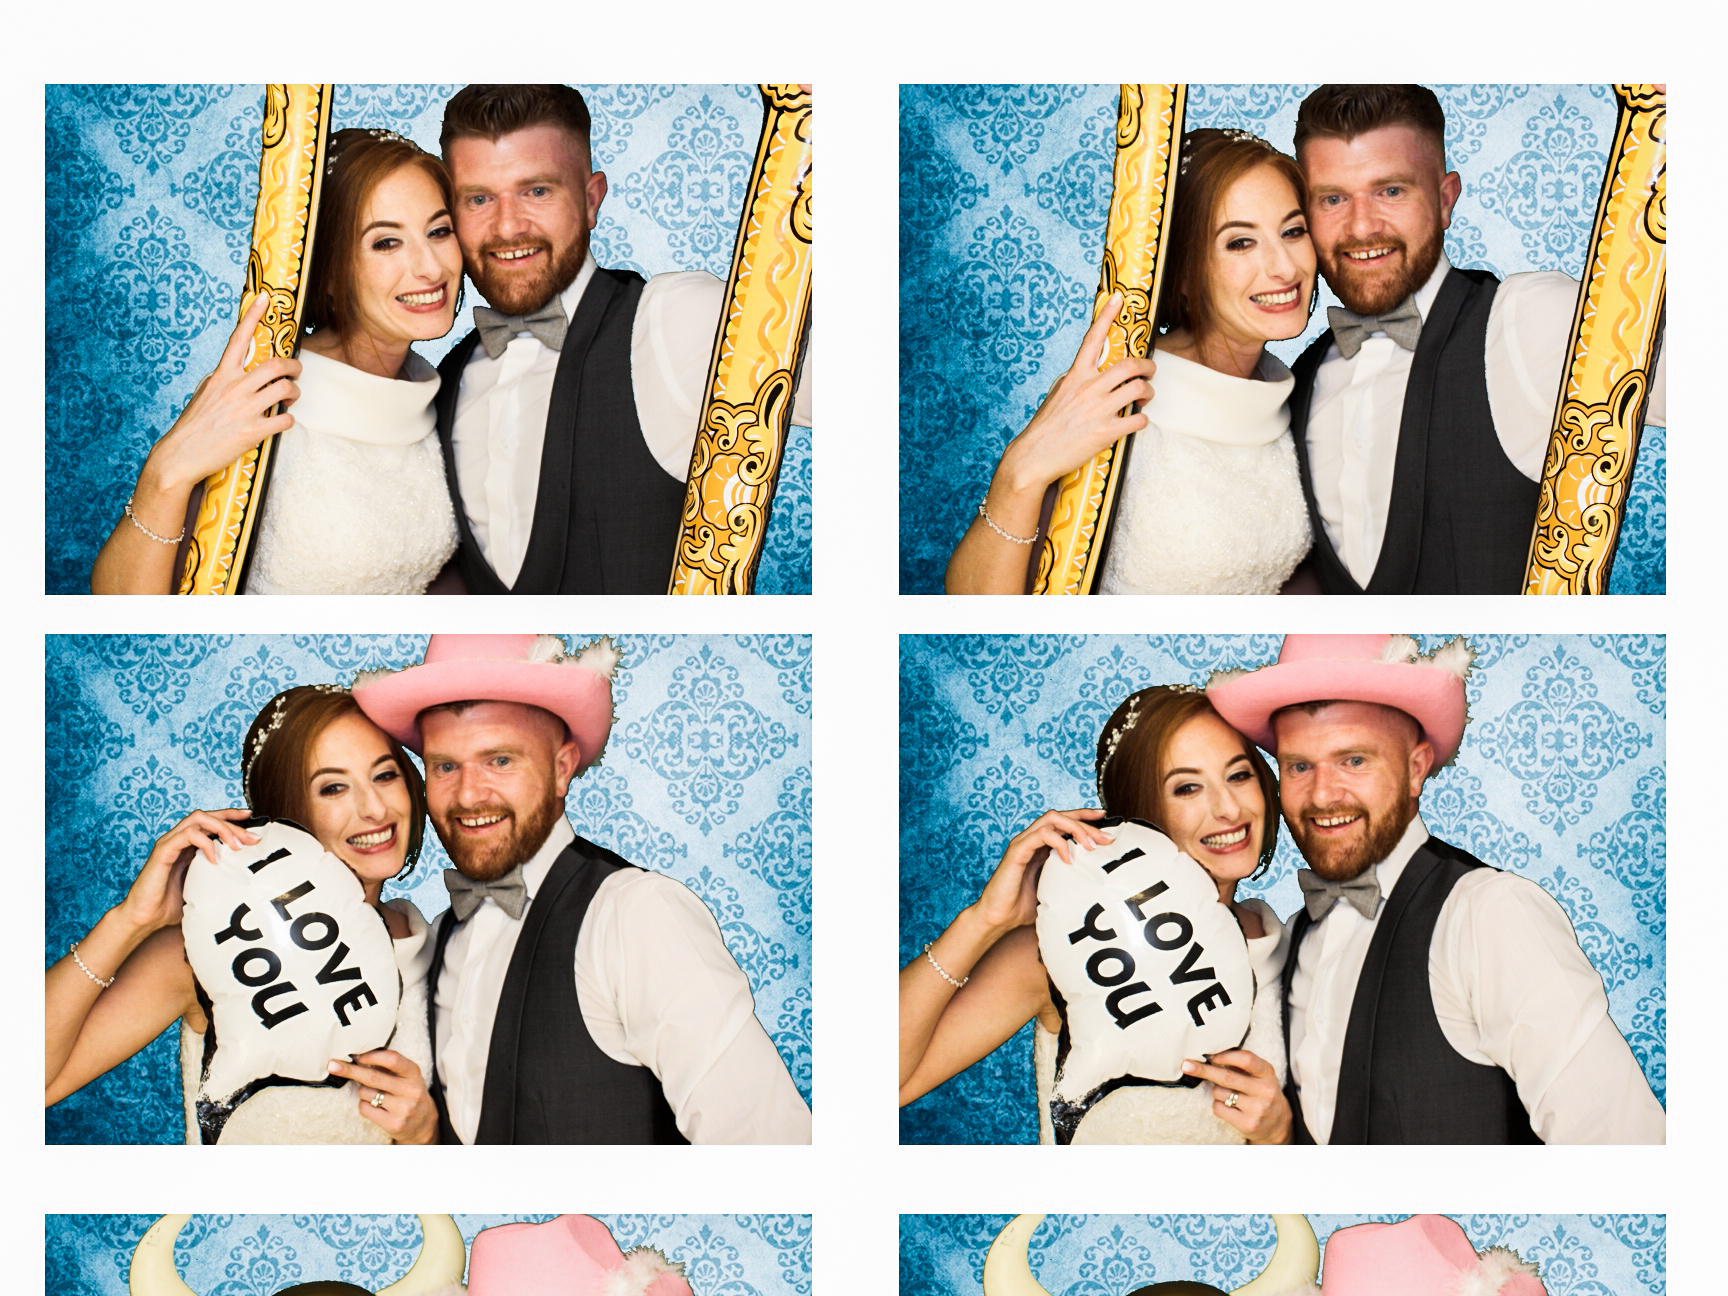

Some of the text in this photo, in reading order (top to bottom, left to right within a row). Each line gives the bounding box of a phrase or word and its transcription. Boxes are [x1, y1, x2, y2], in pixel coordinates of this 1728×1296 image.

[213, 902, 310, 1031] YOU
[247, 847, 379, 1028] I LOVE
[1067, 902, 1164, 1031] YOU
[1101, 847, 1233, 1028] I LOVE
